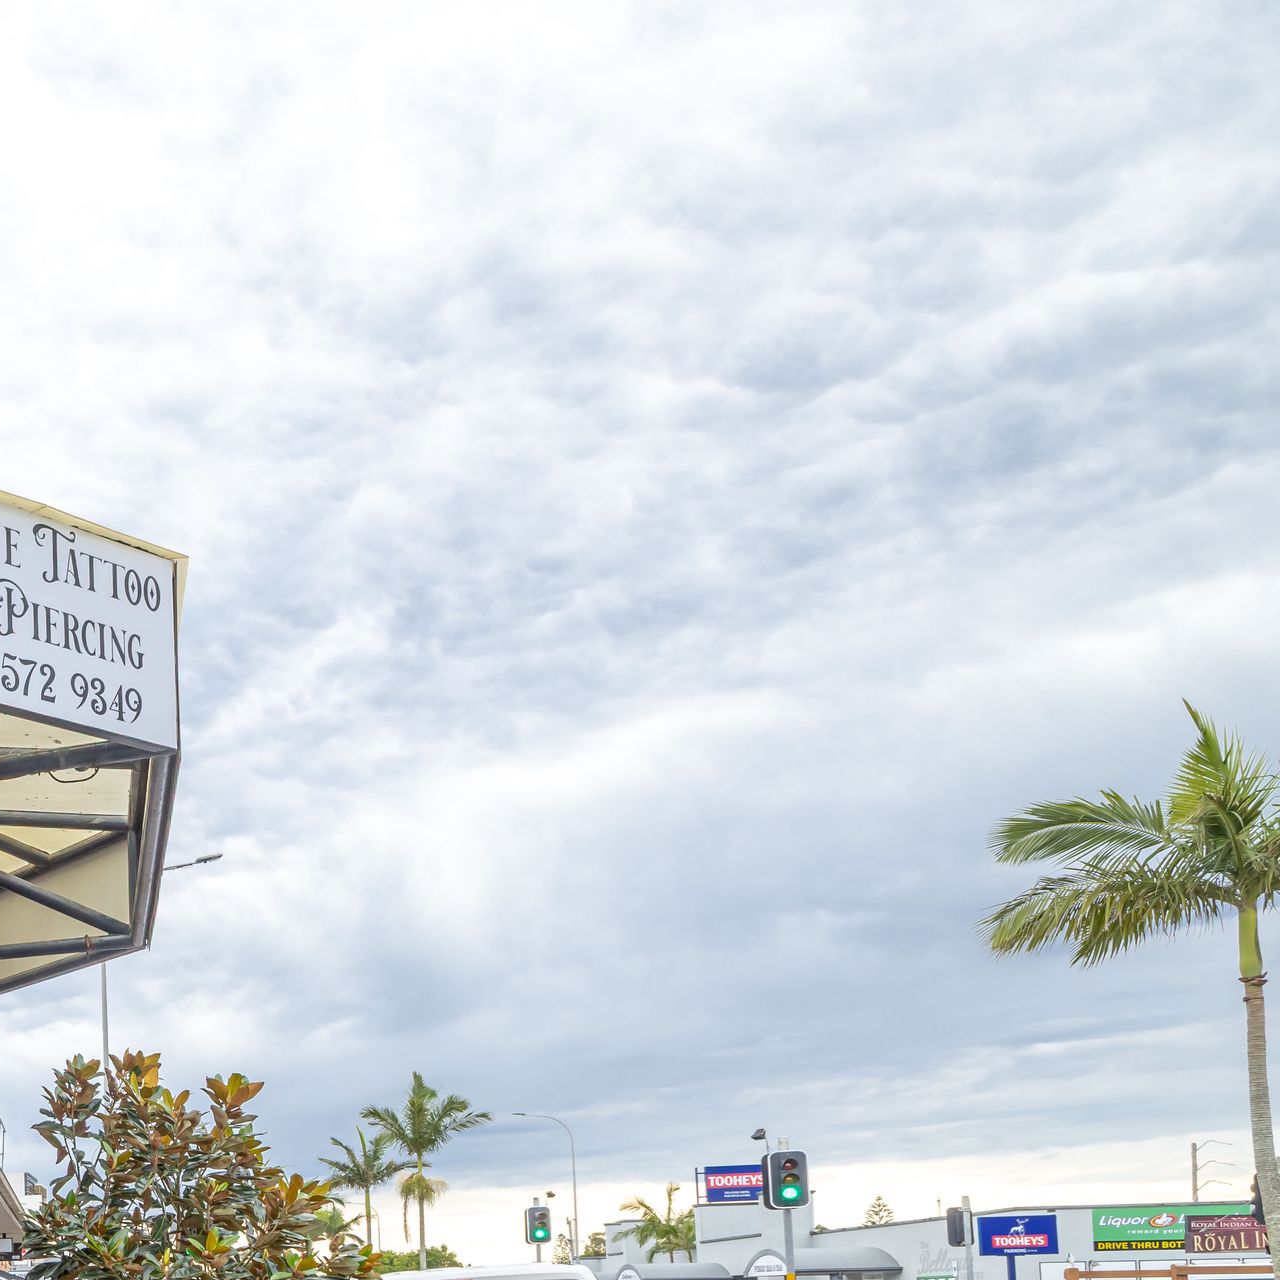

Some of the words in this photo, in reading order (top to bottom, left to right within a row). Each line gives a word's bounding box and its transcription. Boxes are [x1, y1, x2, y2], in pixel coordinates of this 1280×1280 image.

[33, 522, 161, 612] TATTOO
[71, 672, 143, 725] 9349
[708, 1174, 763, 1187] TOOHEYS
[1098, 1215, 1150, 1228] Liquor
[994, 1236, 1046, 1247] TOOHEYS
[1097, 1242, 1129, 1251] DRIVE
[1130, 1241, 1159, 1249] THRU
[1193, 1231, 1249, 1252] ROYAL
